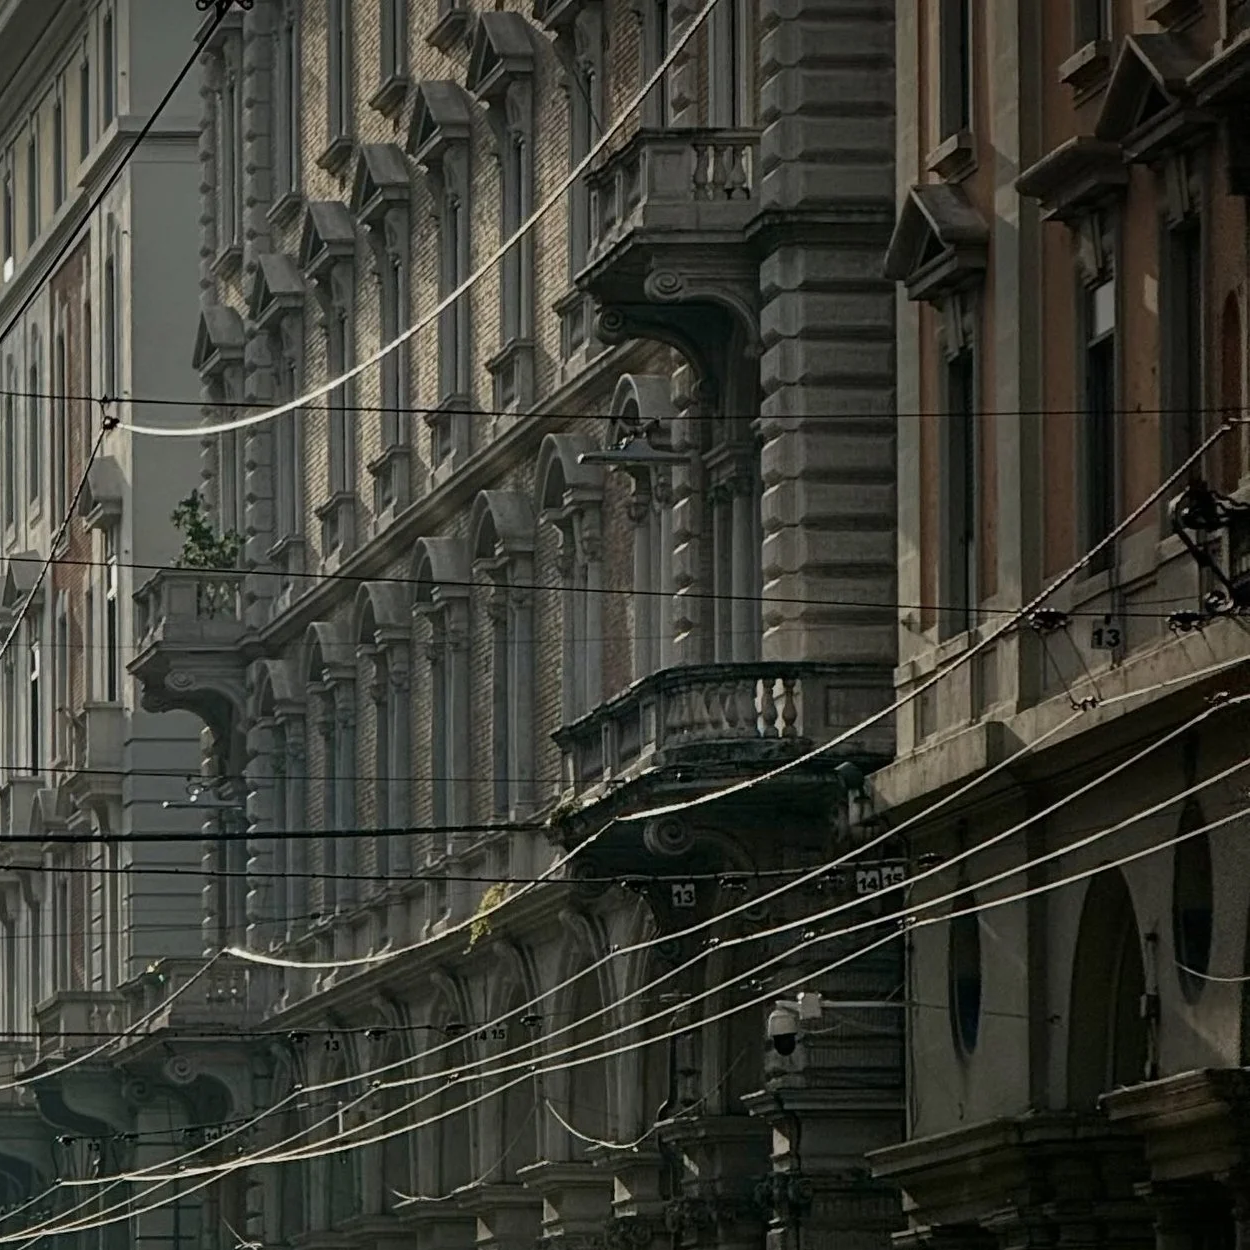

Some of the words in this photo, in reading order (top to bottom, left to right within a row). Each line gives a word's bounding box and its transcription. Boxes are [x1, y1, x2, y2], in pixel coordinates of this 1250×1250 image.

[1093, 628, 1120, 647] 13
[858, 877, 878, 890] 14
[674, 890, 694, 904] 13
[492, 1029, 505, 1039] 15
[324, 1041, 339, 1051] 13
